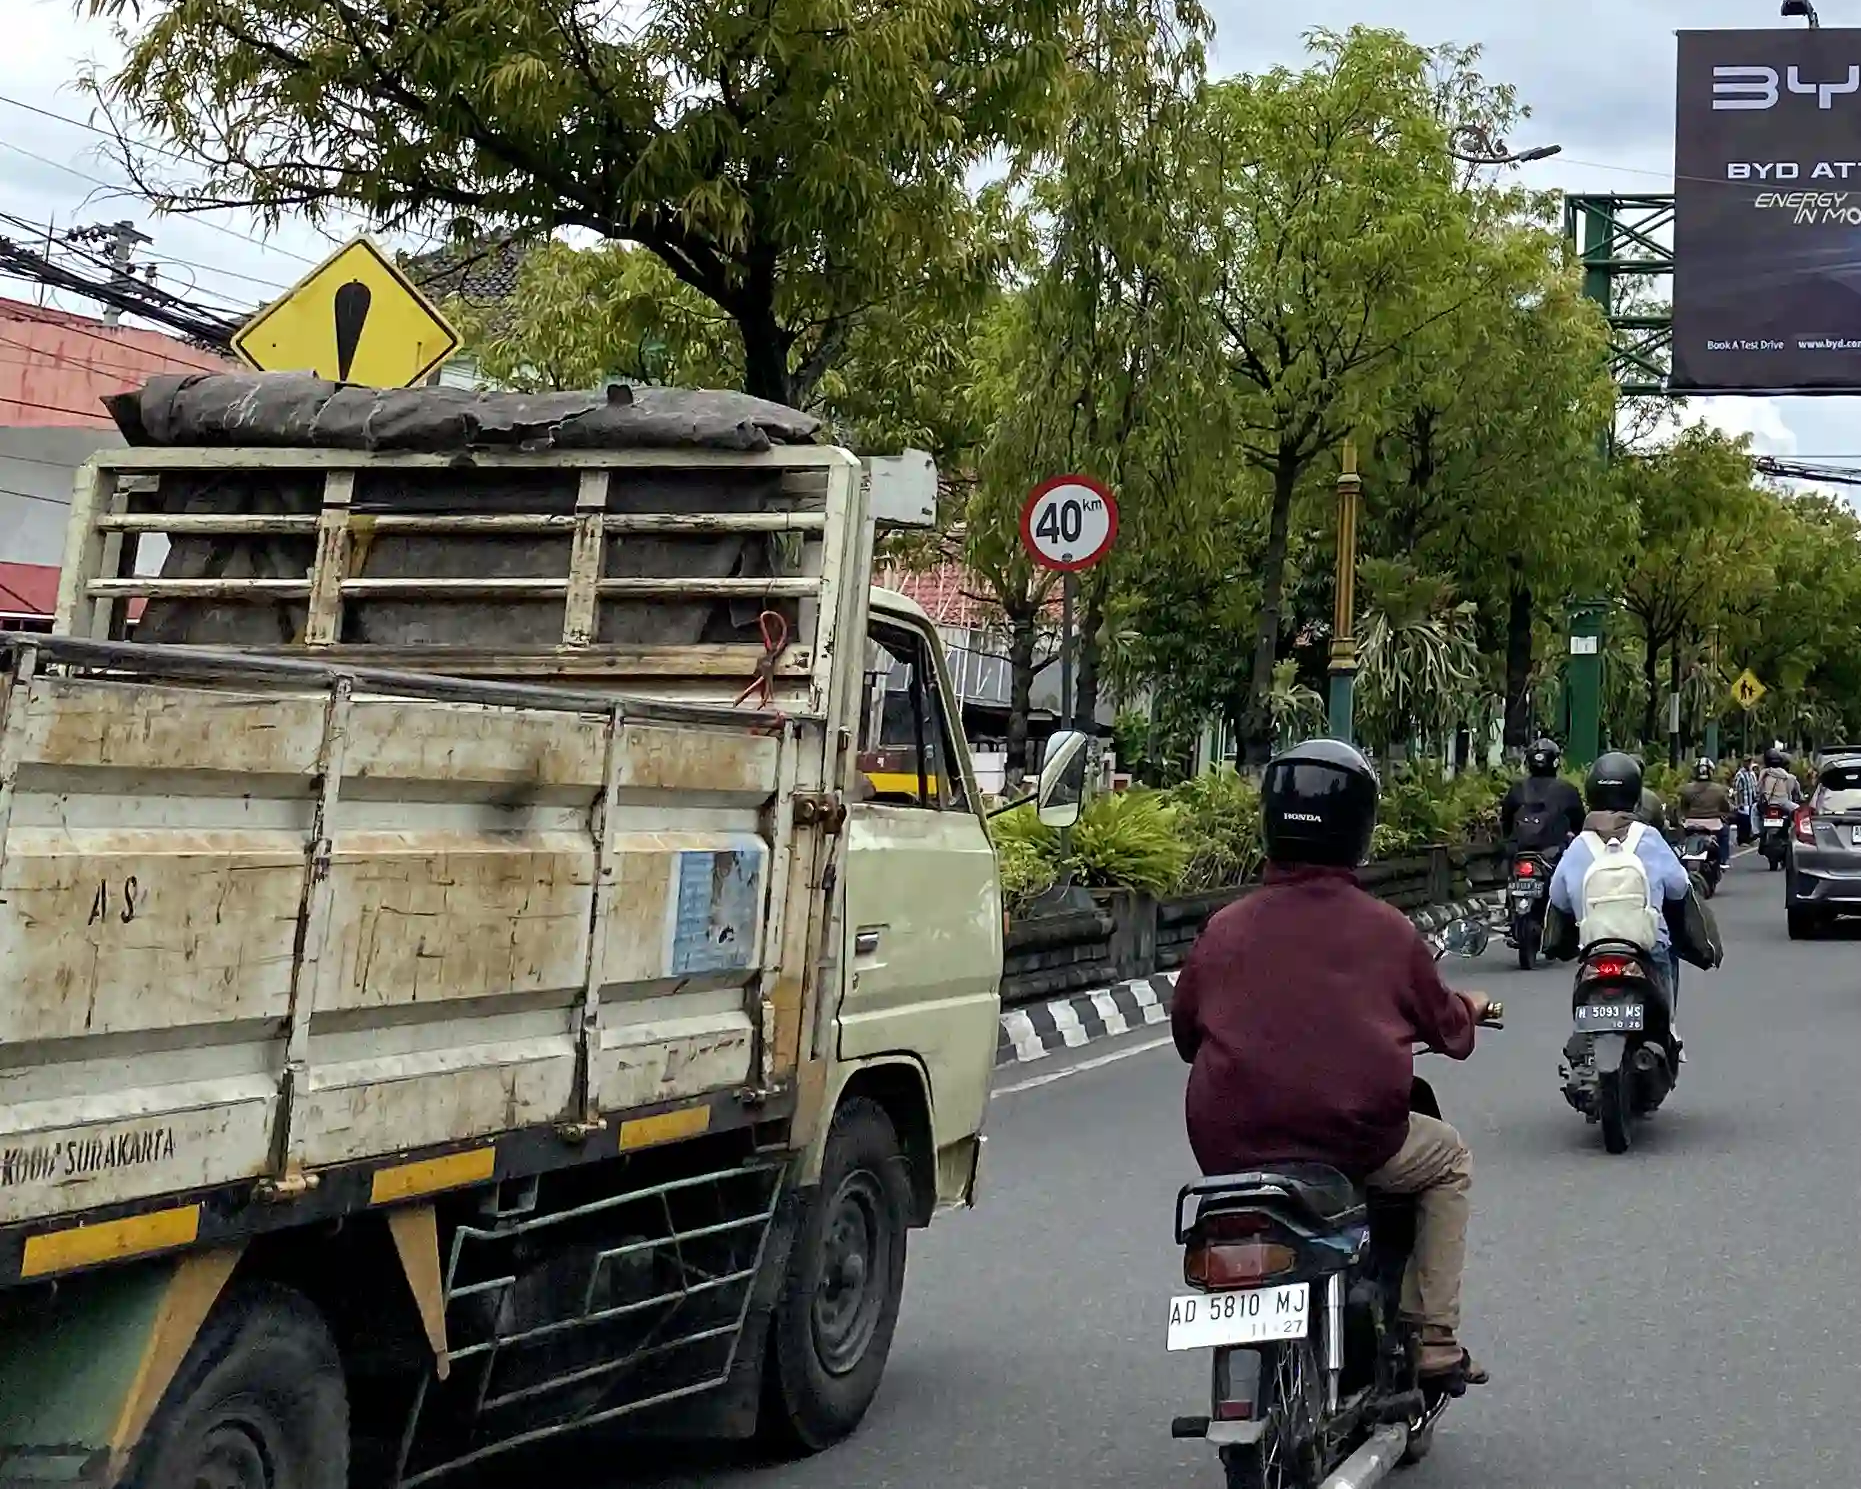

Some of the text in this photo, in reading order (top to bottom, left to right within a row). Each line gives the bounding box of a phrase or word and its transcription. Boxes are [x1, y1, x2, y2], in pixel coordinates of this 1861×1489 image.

[1727, 162, 1799, 180] BYD
[1754, 192, 1849, 209] ENERGY
[1793, 207, 1818, 225] IN
[1707, 338, 1784, 350] Book A Test Drive
[1036, 498, 1102, 544] 40 km
[1283, 812, 1322, 823] HONDA
[1592, 1005, 1619, 1018] 5093
[1625, 1005, 1641, 1018] MS
[1170, 1289, 1305, 1326] AD 5810 MJ
